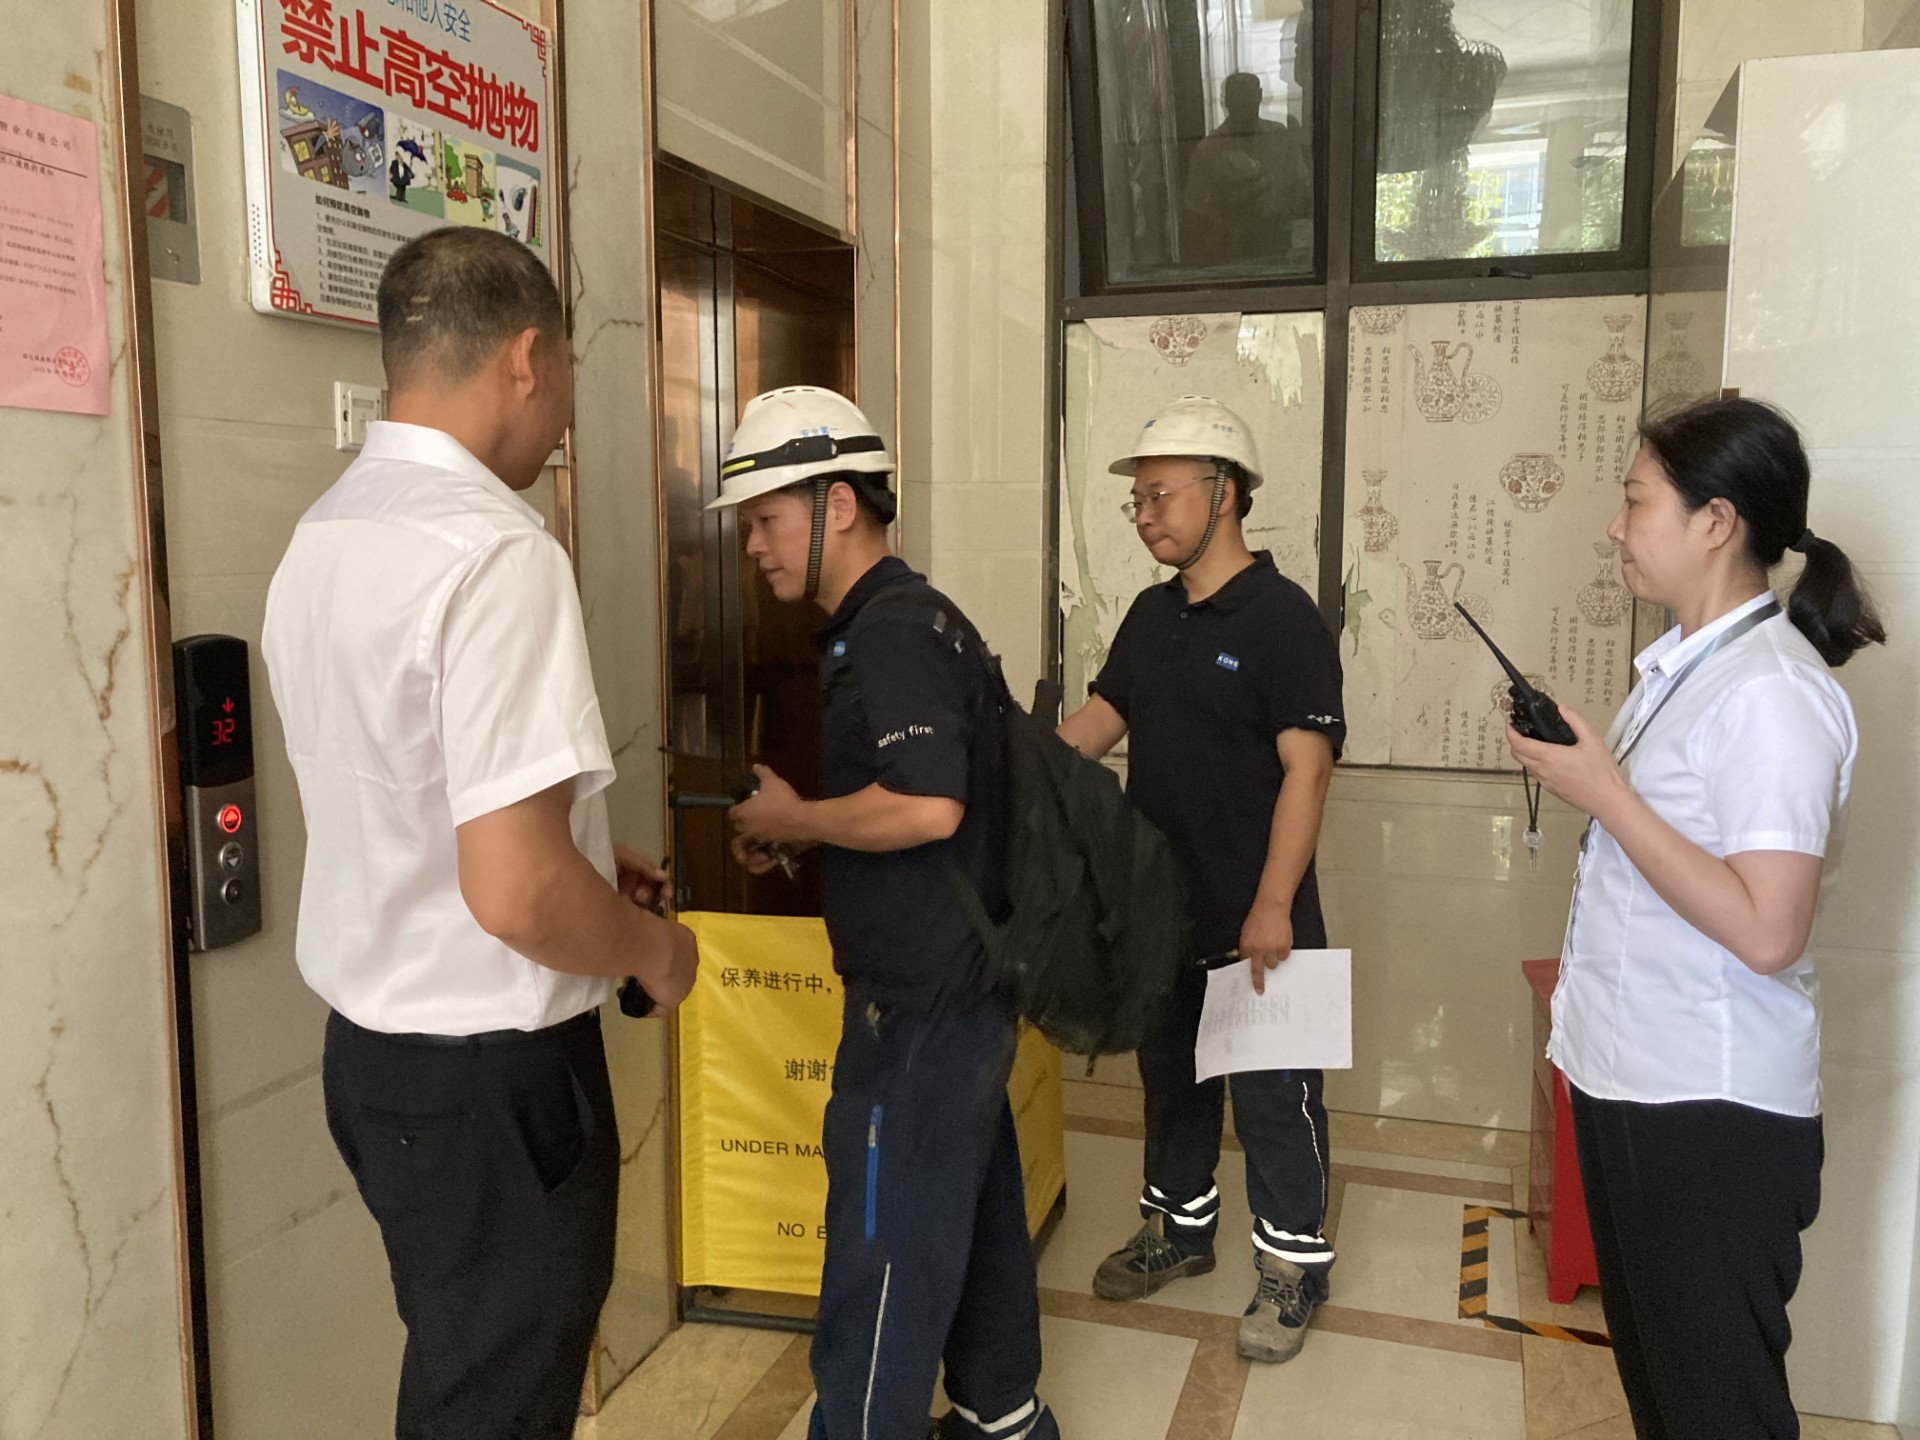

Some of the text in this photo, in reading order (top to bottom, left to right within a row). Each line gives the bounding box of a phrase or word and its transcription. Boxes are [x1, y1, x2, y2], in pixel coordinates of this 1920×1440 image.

[280, 0, 539, 153] 禁止高空抛物
[1217, 655, 1239, 668] KONE
[211, 718, 236, 746] 32
[877, 724, 934, 748] safety first
[721, 1138, 825, 1159] UNDER MA
[777, 1220, 827, 1240] NO E
